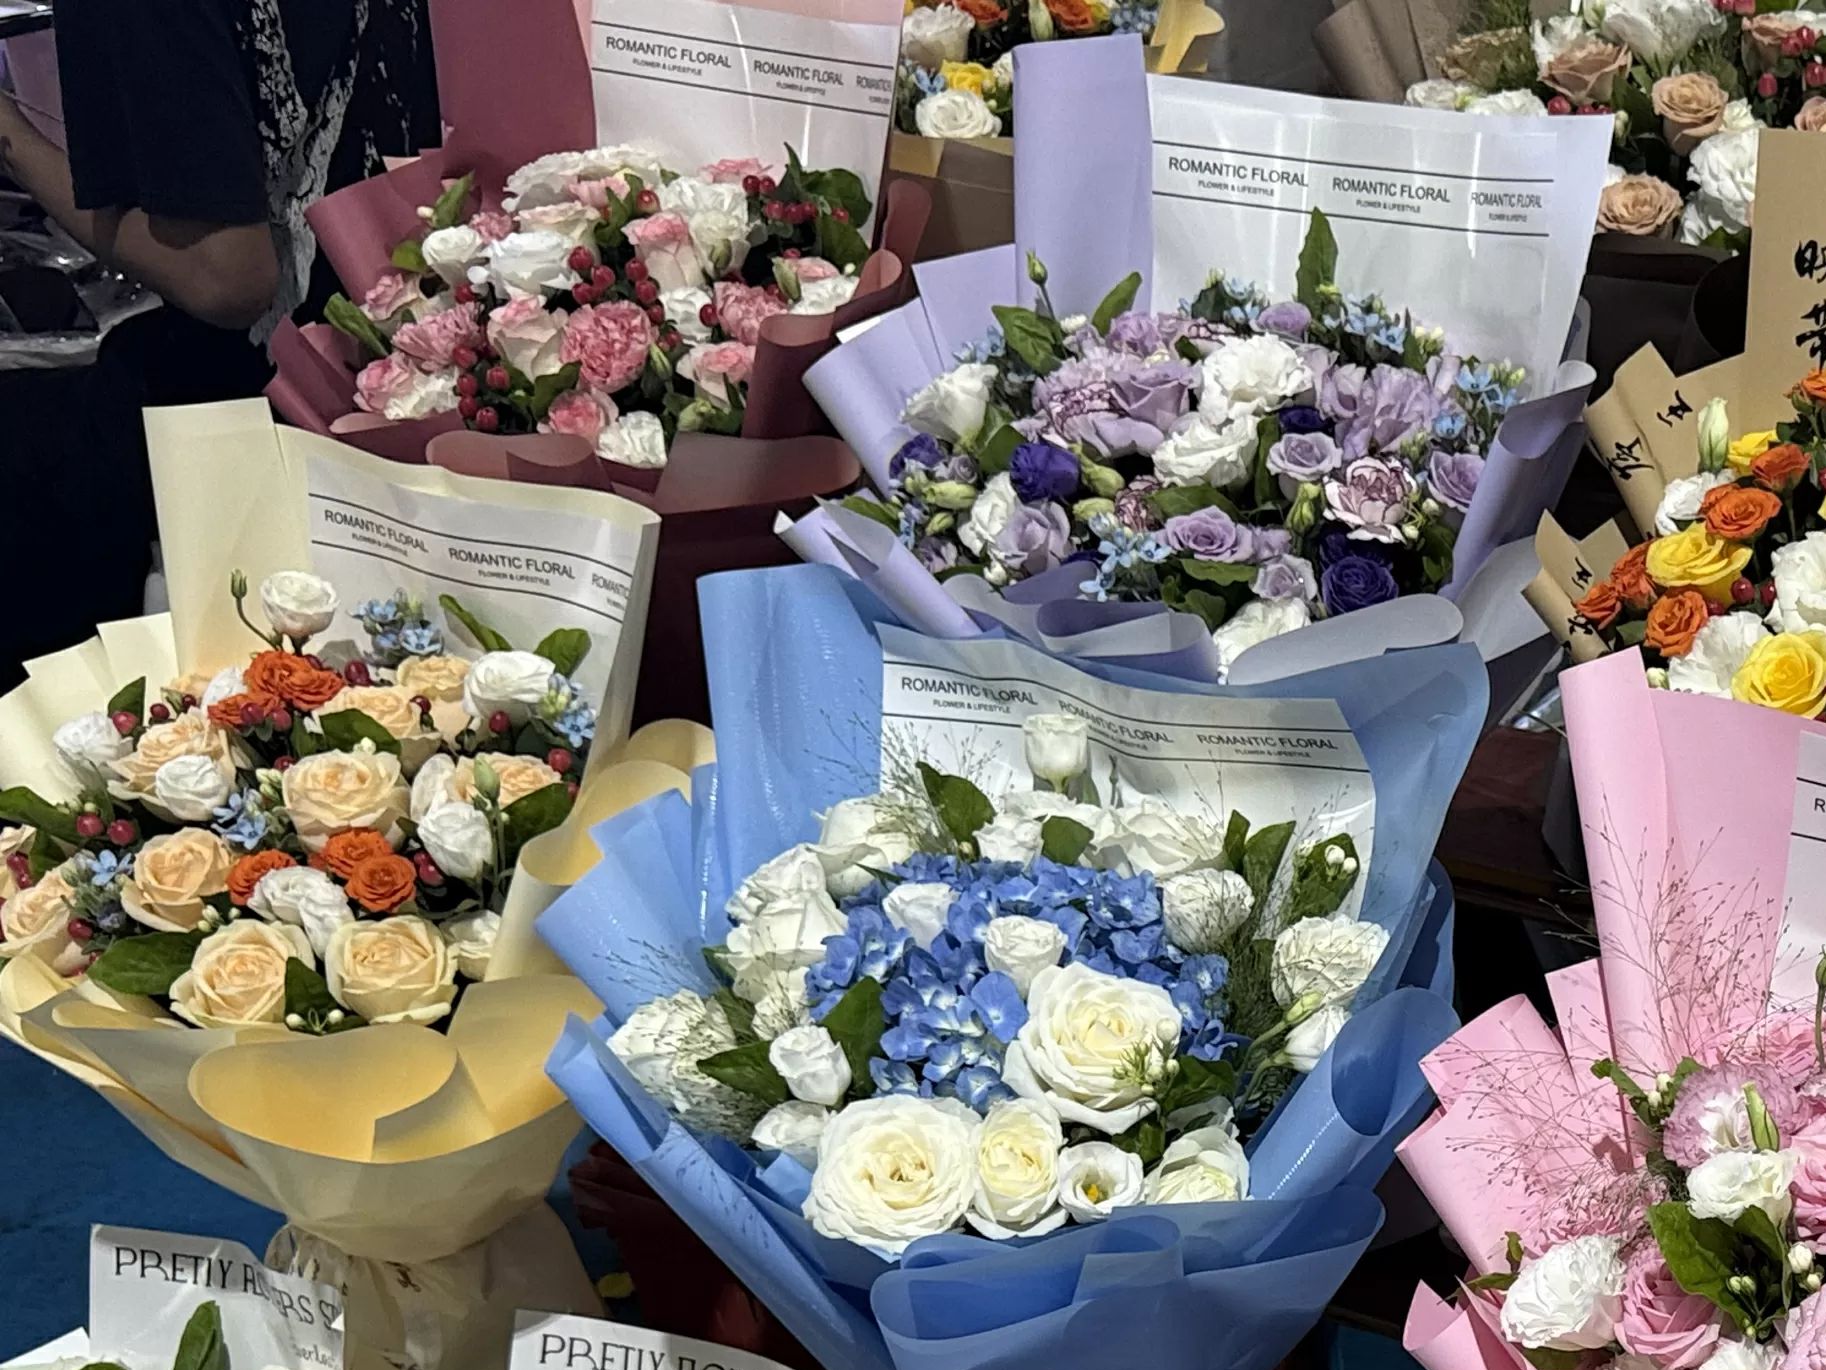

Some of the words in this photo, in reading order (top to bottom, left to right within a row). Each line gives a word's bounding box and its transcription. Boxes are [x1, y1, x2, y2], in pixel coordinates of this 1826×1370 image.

[606, 36, 677, 59] ROMANTIC
[681, 49, 731, 68] FLORAL
[754, 60, 810, 80] ROMANTIC
[813, 66, 844, 86] FLORAL
[1169, 156, 1247, 179] ROMANTIC
[1251, 167, 1309, 187] FLORAL
[1331, 177, 1396, 197] ROMANTIC
[1400, 185, 1450, 203] FLORAL
[1471, 192, 1514, 208] ROMANTIC
[1517, 195, 1542, 208] FLORAL
[324, 509, 386, 538] ROMANTIC
[387, 527, 429, 554] FLORAL
[448, 547, 524, 571] ROMANTIC
[525, 557, 576, 580] FLORAL
[901, 676, 981, 698] ROMANTIC
[982, 688, 1039, 706] FLORAL
[1059, 700, 1116, 735] ROMANTIC
[1118, 725, 1174, 744] FLORAL
[1197, 734, 1277, 748] ROMANTIC
[1279, 737, 1338, 750] FLORAL
